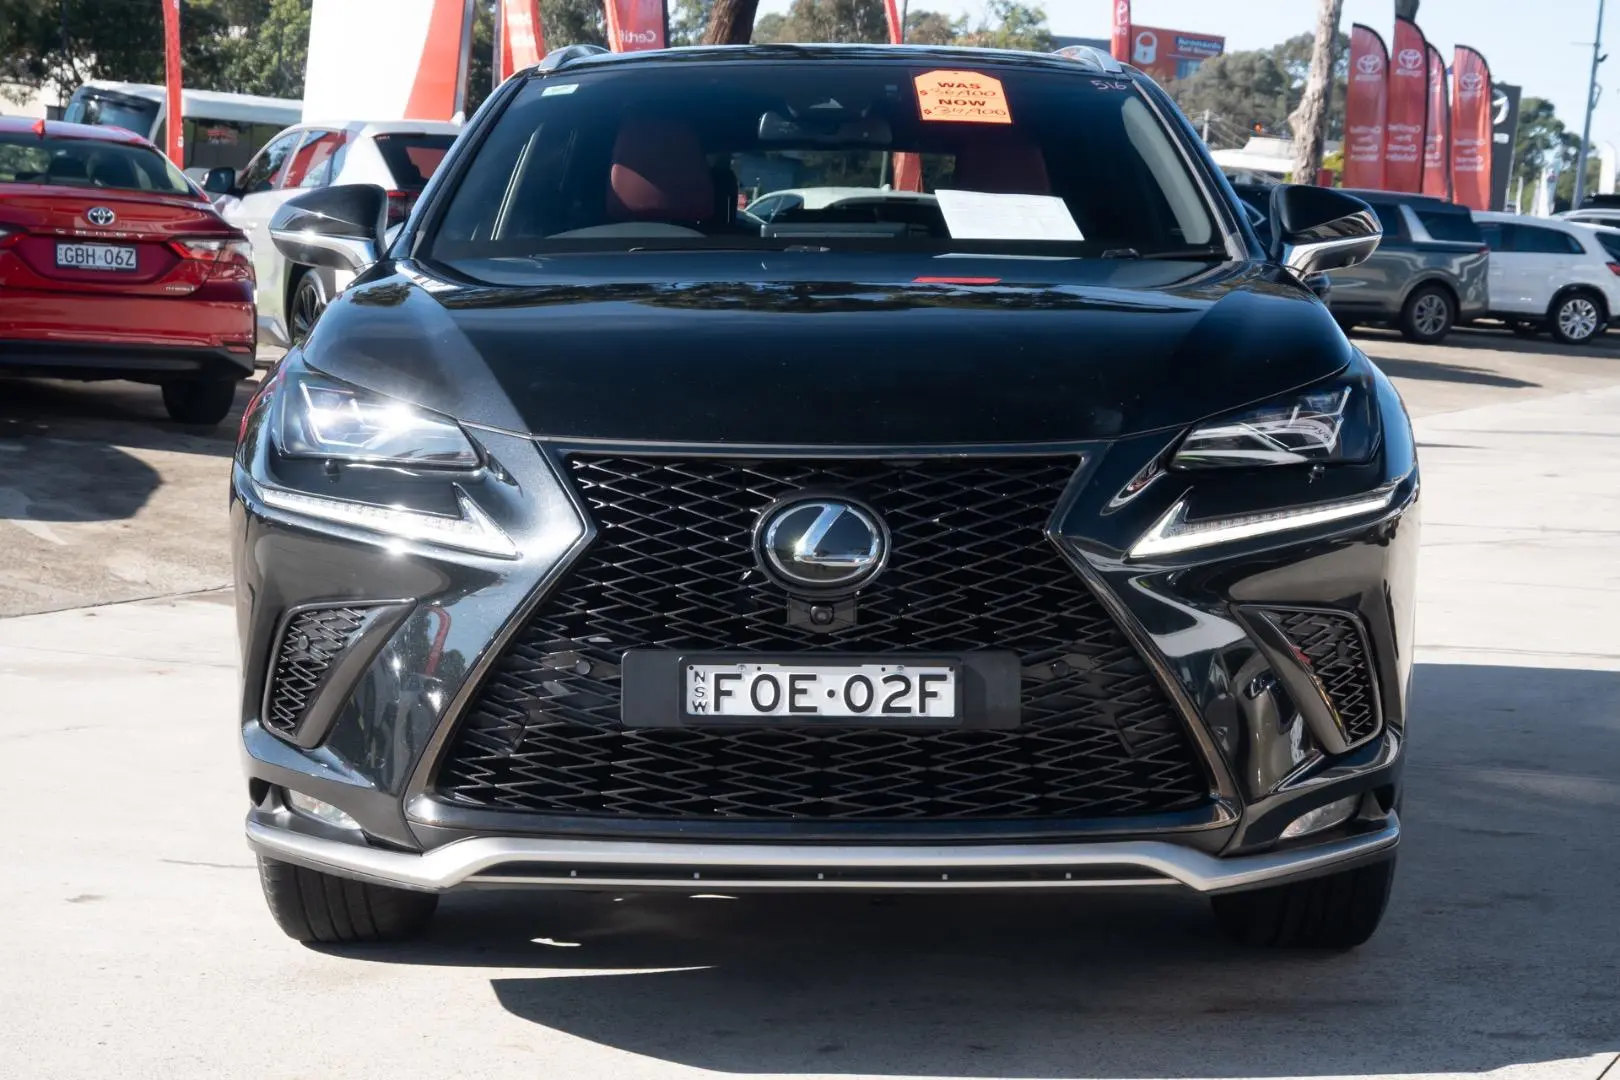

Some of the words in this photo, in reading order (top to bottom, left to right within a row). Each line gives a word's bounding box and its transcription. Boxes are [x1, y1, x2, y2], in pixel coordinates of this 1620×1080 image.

[938, 99, 986, 107] NOW
[64, 247, 96, 264] GBH
[104, 249, 135, 266] 06Z
